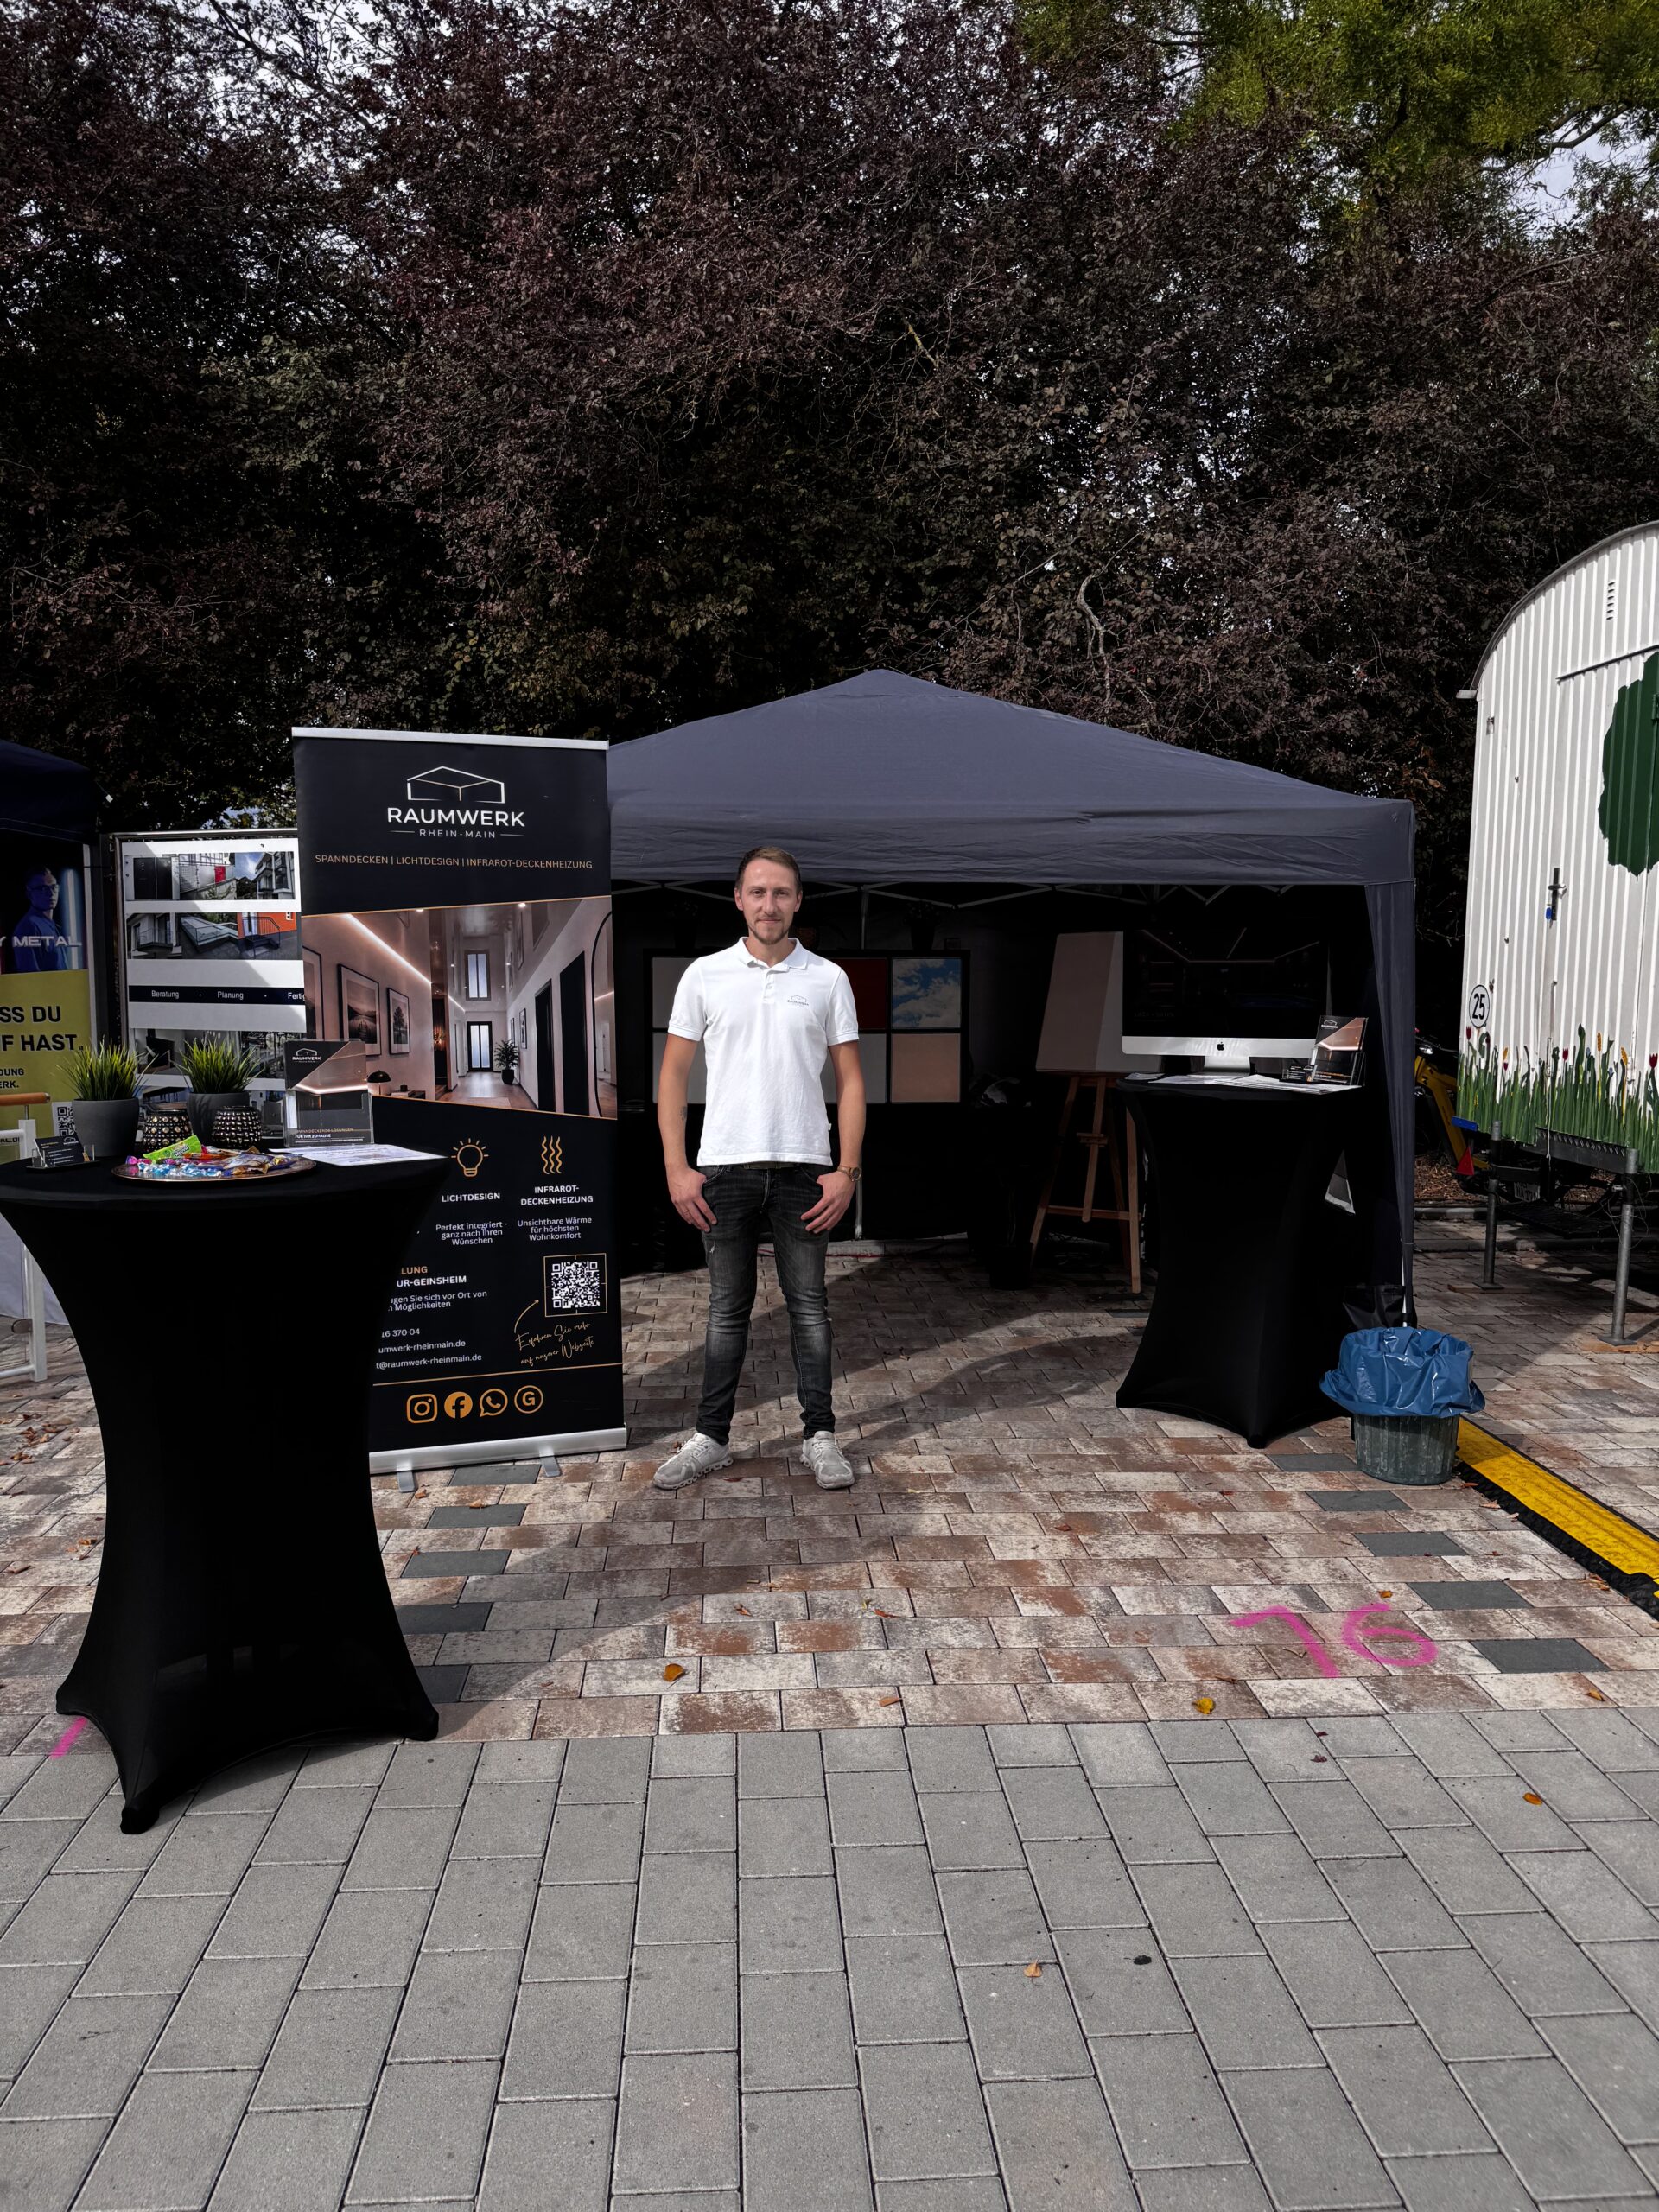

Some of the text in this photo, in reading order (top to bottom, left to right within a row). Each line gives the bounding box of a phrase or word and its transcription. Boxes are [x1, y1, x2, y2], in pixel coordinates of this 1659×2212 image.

[387, 808, 525, 827] RAUMWERK
[419, 829, 495, 838] RHEIN-MAIN
[315, 855, 388, 864] SPANNDECKEN
[397, 856, 459, 866] LICHTDESIGN
[467, 858, 592, 869] INFRAROT-DECKENHEIZUNG
[13, 936, 82, 947] METAL
[152, 990, 179, 999] Beratung
[218, 991, 244, 1000] Planung
[1472, 993, 1485, 1020] 25
[0, 1006, 60, 1023] SS DU
[2, 1035, 14, 1051] F
[534, 1185, 579, 1193] INFRAROT-
[442, 1192, 500, 1203] LICHTDESIGN
[520, 1196, 594, 1205] DECKENHEIZUNG
[435, 1223, 464, 1231] Perfekt
[466, 1221, 503, 1231] integriert
[518, 1217, 563, 1227] Unsichtbare
[461, 1230, 480, 1238] nach
[544, 1224, 579, 1233] höchsten
[529, 1231, 581, 1241] Wohnkomfort
[401, 1266, 429, 1274] LUNG
[397, 1275, 467, 1287] UR-GEINSHEIM
[395, 1300, 451, 1312] Möglichkeiten
[554, 1325, 571, 1342] Sie
[378, 1339, 466, 1354] umwerk-rheinmain.de
[376, 1354, 482, 1370] t@raumwerk-rheinmain.de
